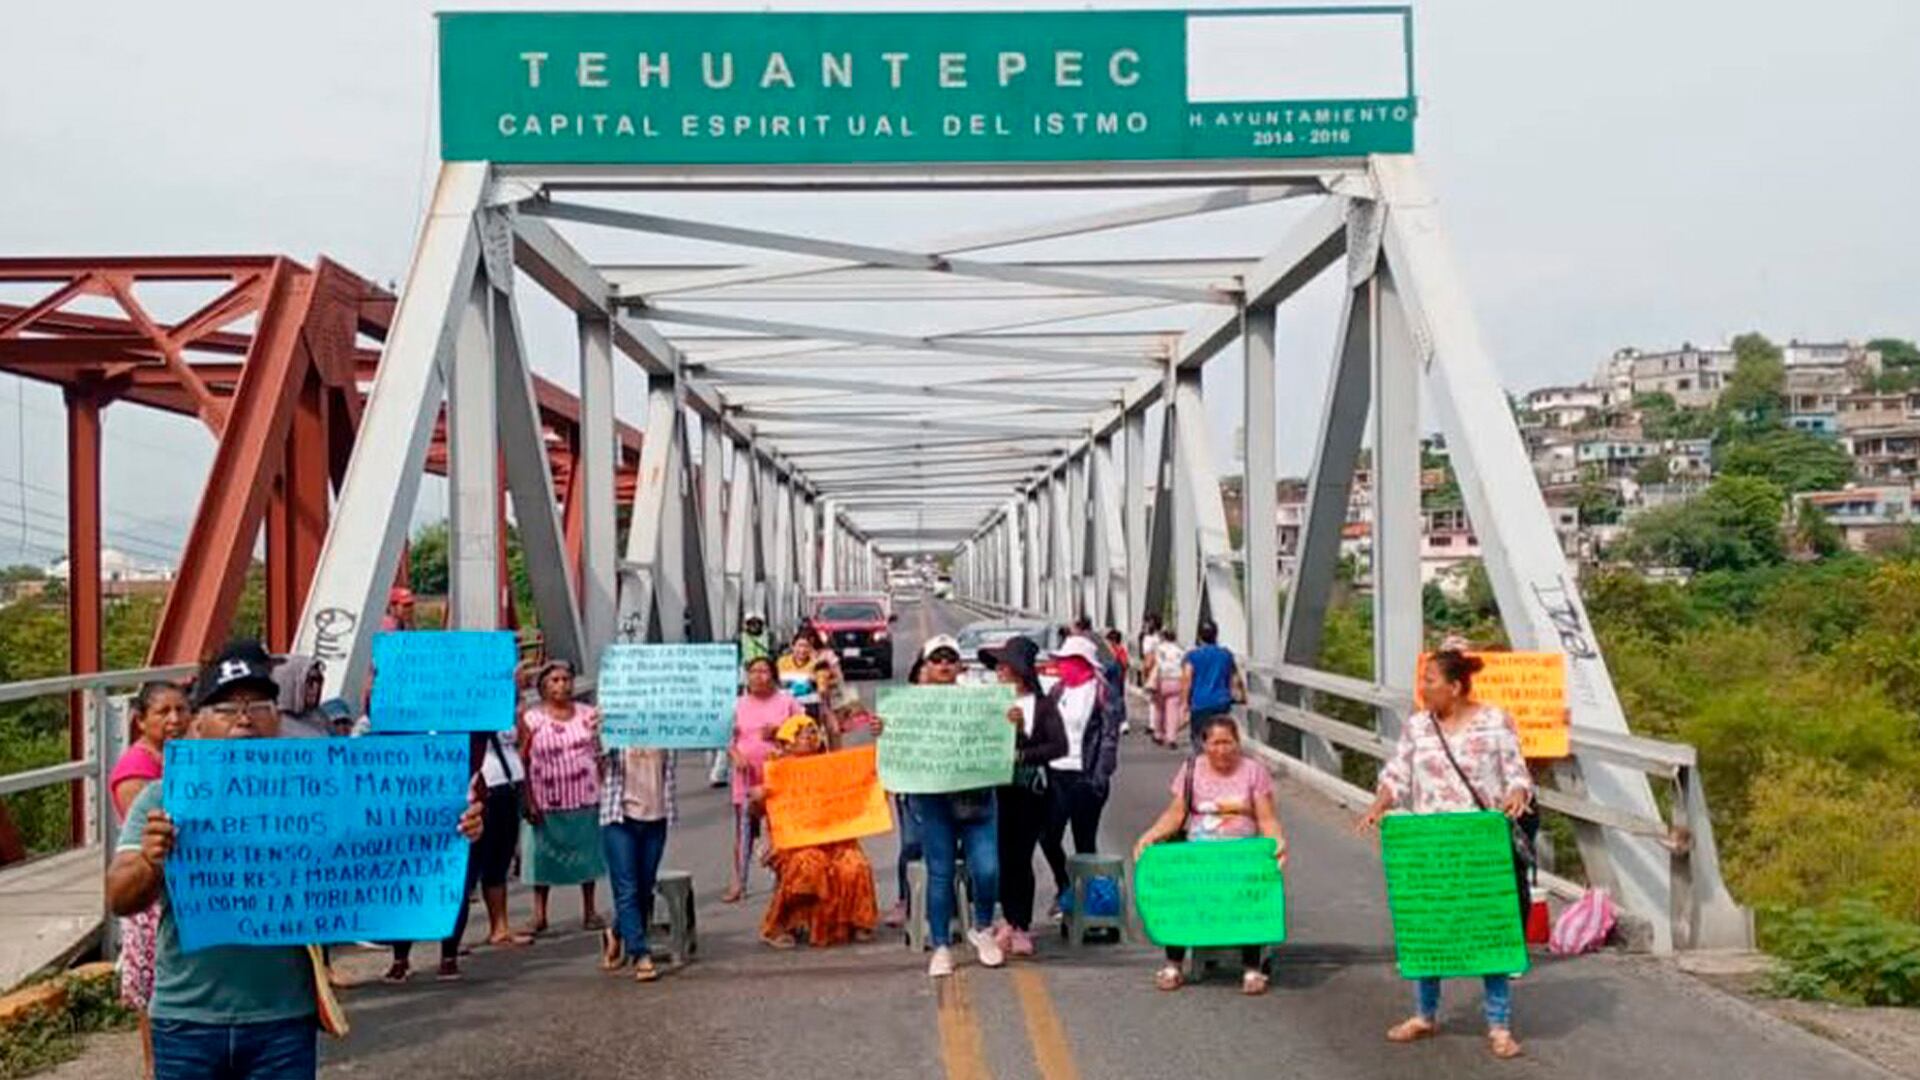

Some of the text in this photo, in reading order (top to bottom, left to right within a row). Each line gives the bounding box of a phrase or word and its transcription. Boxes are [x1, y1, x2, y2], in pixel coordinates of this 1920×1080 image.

[520, 49, 1142, 89] TEHUANTEPEC
[498, 114, 660, 137] CAPITAL
[943, 114, 1010, 136] DEL
[1034, 112, 1148, 135] ISTMO
[1215, 105, 1409, 126] AYUNTAMIENTO
[1253, 131, 1294, 146] 2014
[1310, 129, 1350, 145] 2016
[207, 746, 313, 766] SERVICIO
[327, 744, 410, 766] MEDICO
[423, 742, 468, 764] PARA
[168, 772, 466, 800] LOS ADULTOS MAYORES
[189, 870, 282, 889] MUJERES
[290, 855, 461, 887] EMBARAZADAS
[208, 893, 257, 912] COMO
[267, 893, 296, 912] LA
[238, 911, 367, 938] GENERAL
